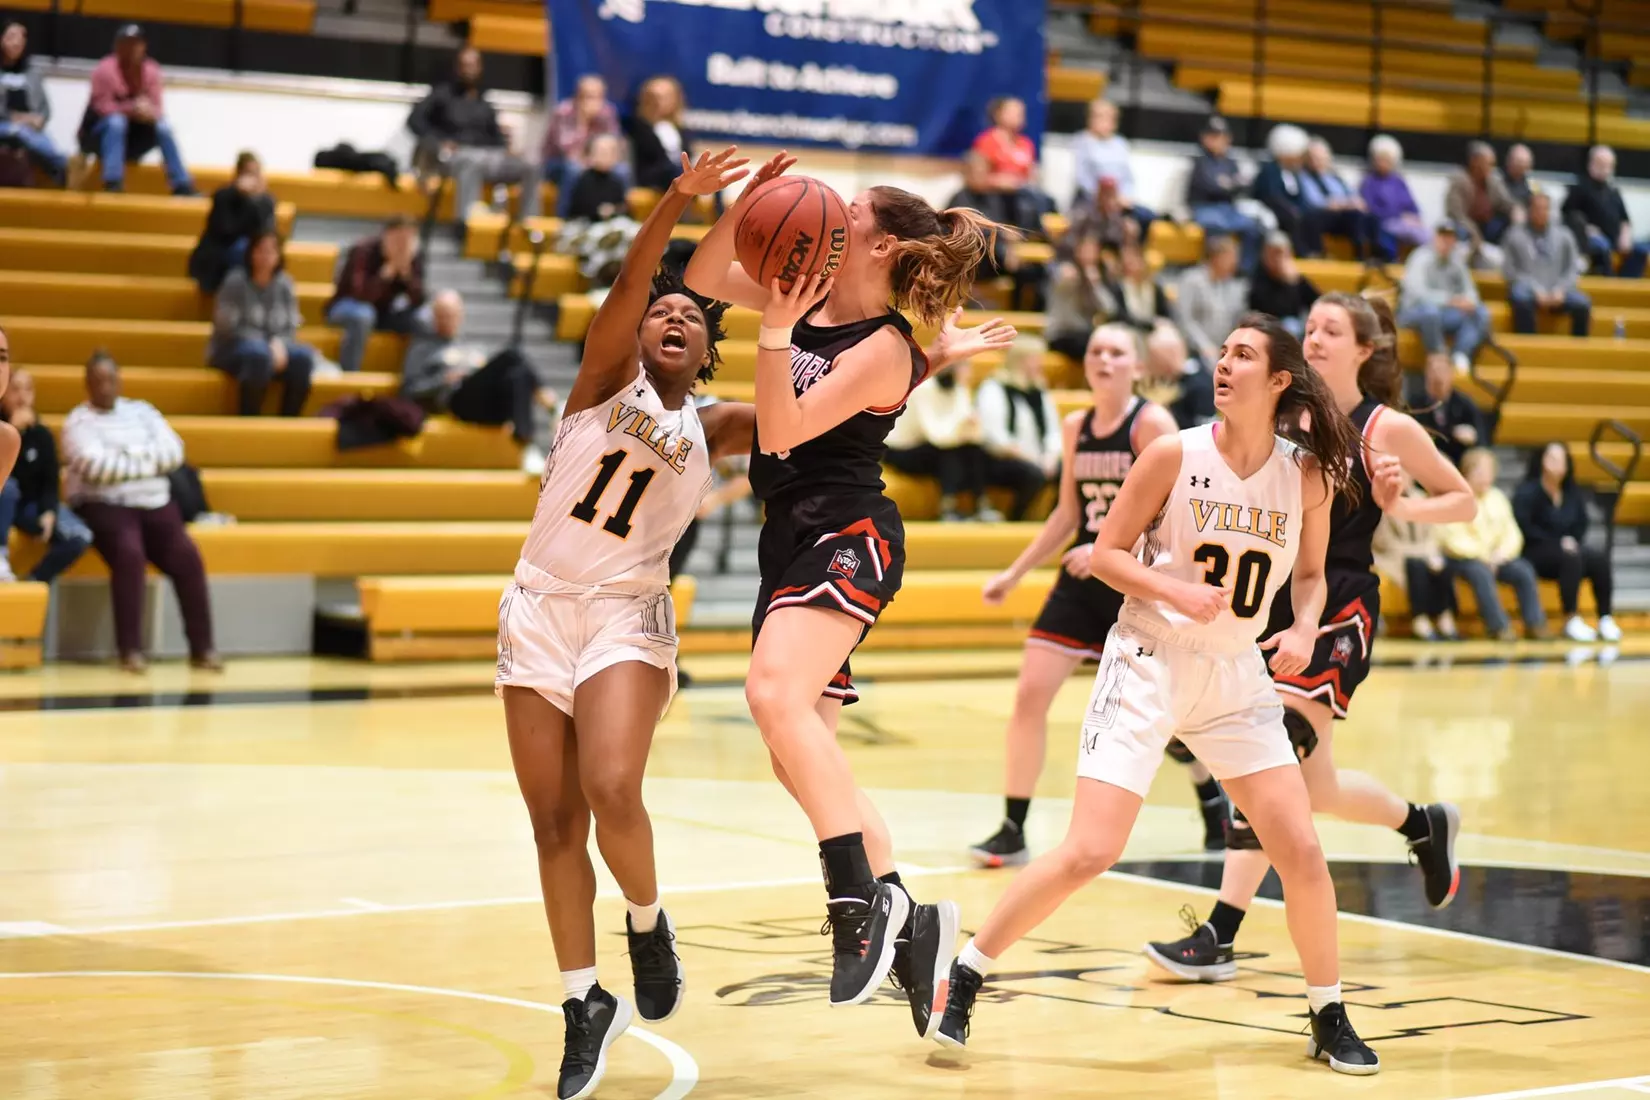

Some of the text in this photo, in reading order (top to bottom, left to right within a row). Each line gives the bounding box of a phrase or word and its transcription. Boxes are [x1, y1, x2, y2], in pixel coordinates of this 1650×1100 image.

[707, 52, 898, 99] Built to Achieve
[606, 401, 693, 476] VILLE
[569, 449, 656, 540] 11
[1189, 498, 1288, 549] VILLE
[1193, 543, 1272, 618] 30
